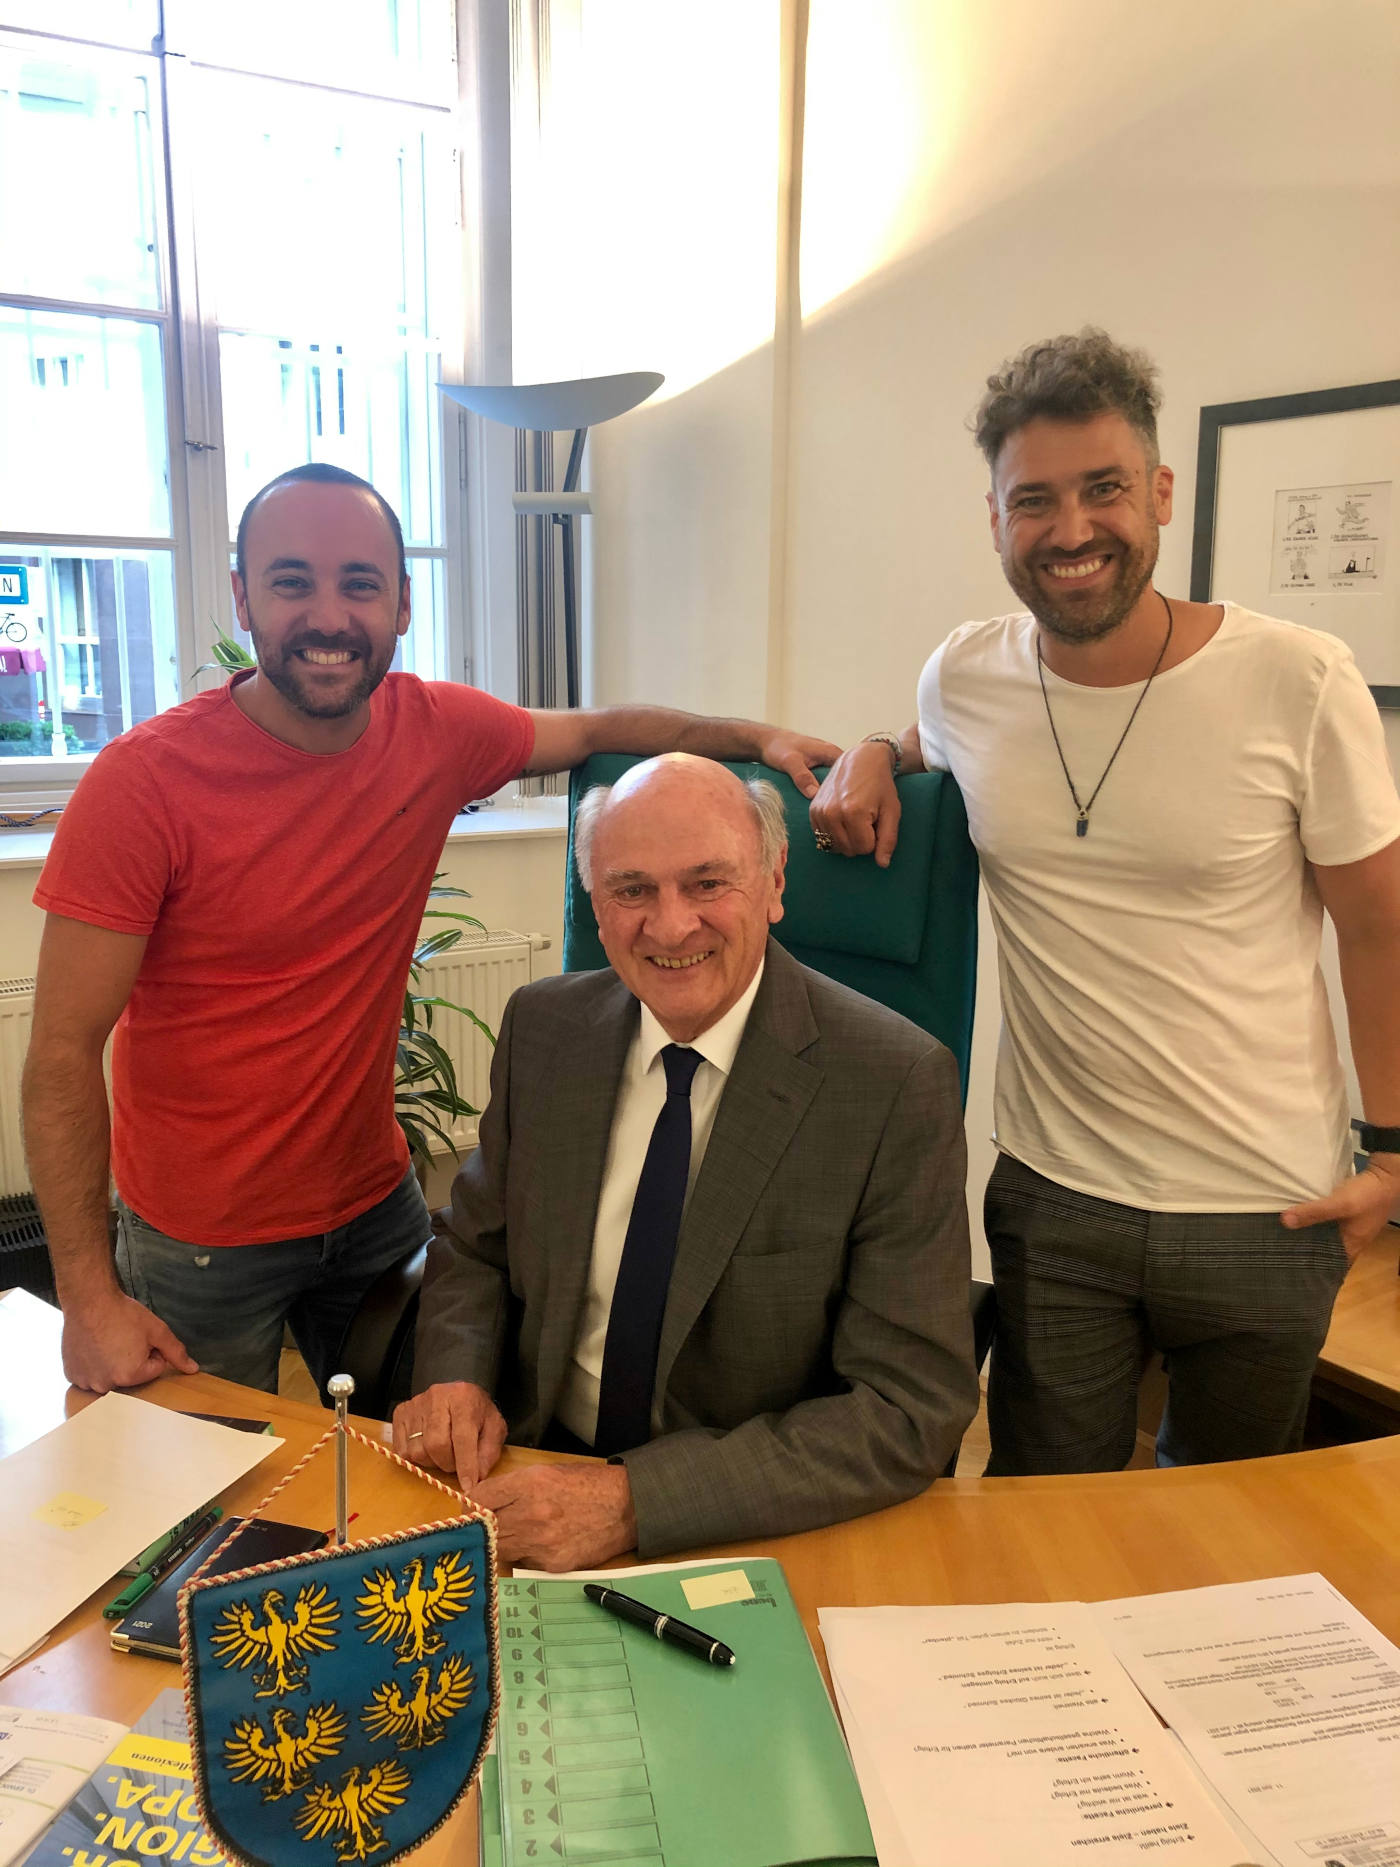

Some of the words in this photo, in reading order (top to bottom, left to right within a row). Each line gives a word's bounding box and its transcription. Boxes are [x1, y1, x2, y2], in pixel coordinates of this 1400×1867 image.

[503, 1583, 520, 1597] 12
[503, 1605, 521, 1619] 11
[132, 1620, 153, 1629] 2021
[506, 1625, 524, 1639] 10
[511, 1648, 522, 1661] 9
[513, 1670, 524, 1684] 8
[994, 1679, 1017, 1687] Erfolg
[515, 1695, 526, 1709] 7
[516, 1721, 528, 1737] 6
[1082, 1728, 1111, 1738] Welche
[1098, 1739, 1117, 1747] Was
[131, 1752, 193, 1771] flexionen
[518, 1749, 530, 1765] 5
[520, 1778, 532, 1795] 4
[1052, 1778, 1080, 1788] Erfolg?
[1124, 1782, 1143, 1790] Was
[1051, 1790, 1078, 1800] Erfolg?
[1077, 1800, 1107, 1810] wichtig?
[1115, 1802, 1163, 1816] persönliche
[522, 1808, 535, 1826] 3
[1140, 1826, 1168, 1836] haben
[1168, 1823, 1189, 1832] Ziele
[1070, 1836, 1111, 1847] erreichen
[1112, 1832, 1134, 1842] Ziele
[1160, 1836, 1186, 1845] Erfolg
[525, 1839, 538, 1857] 2
